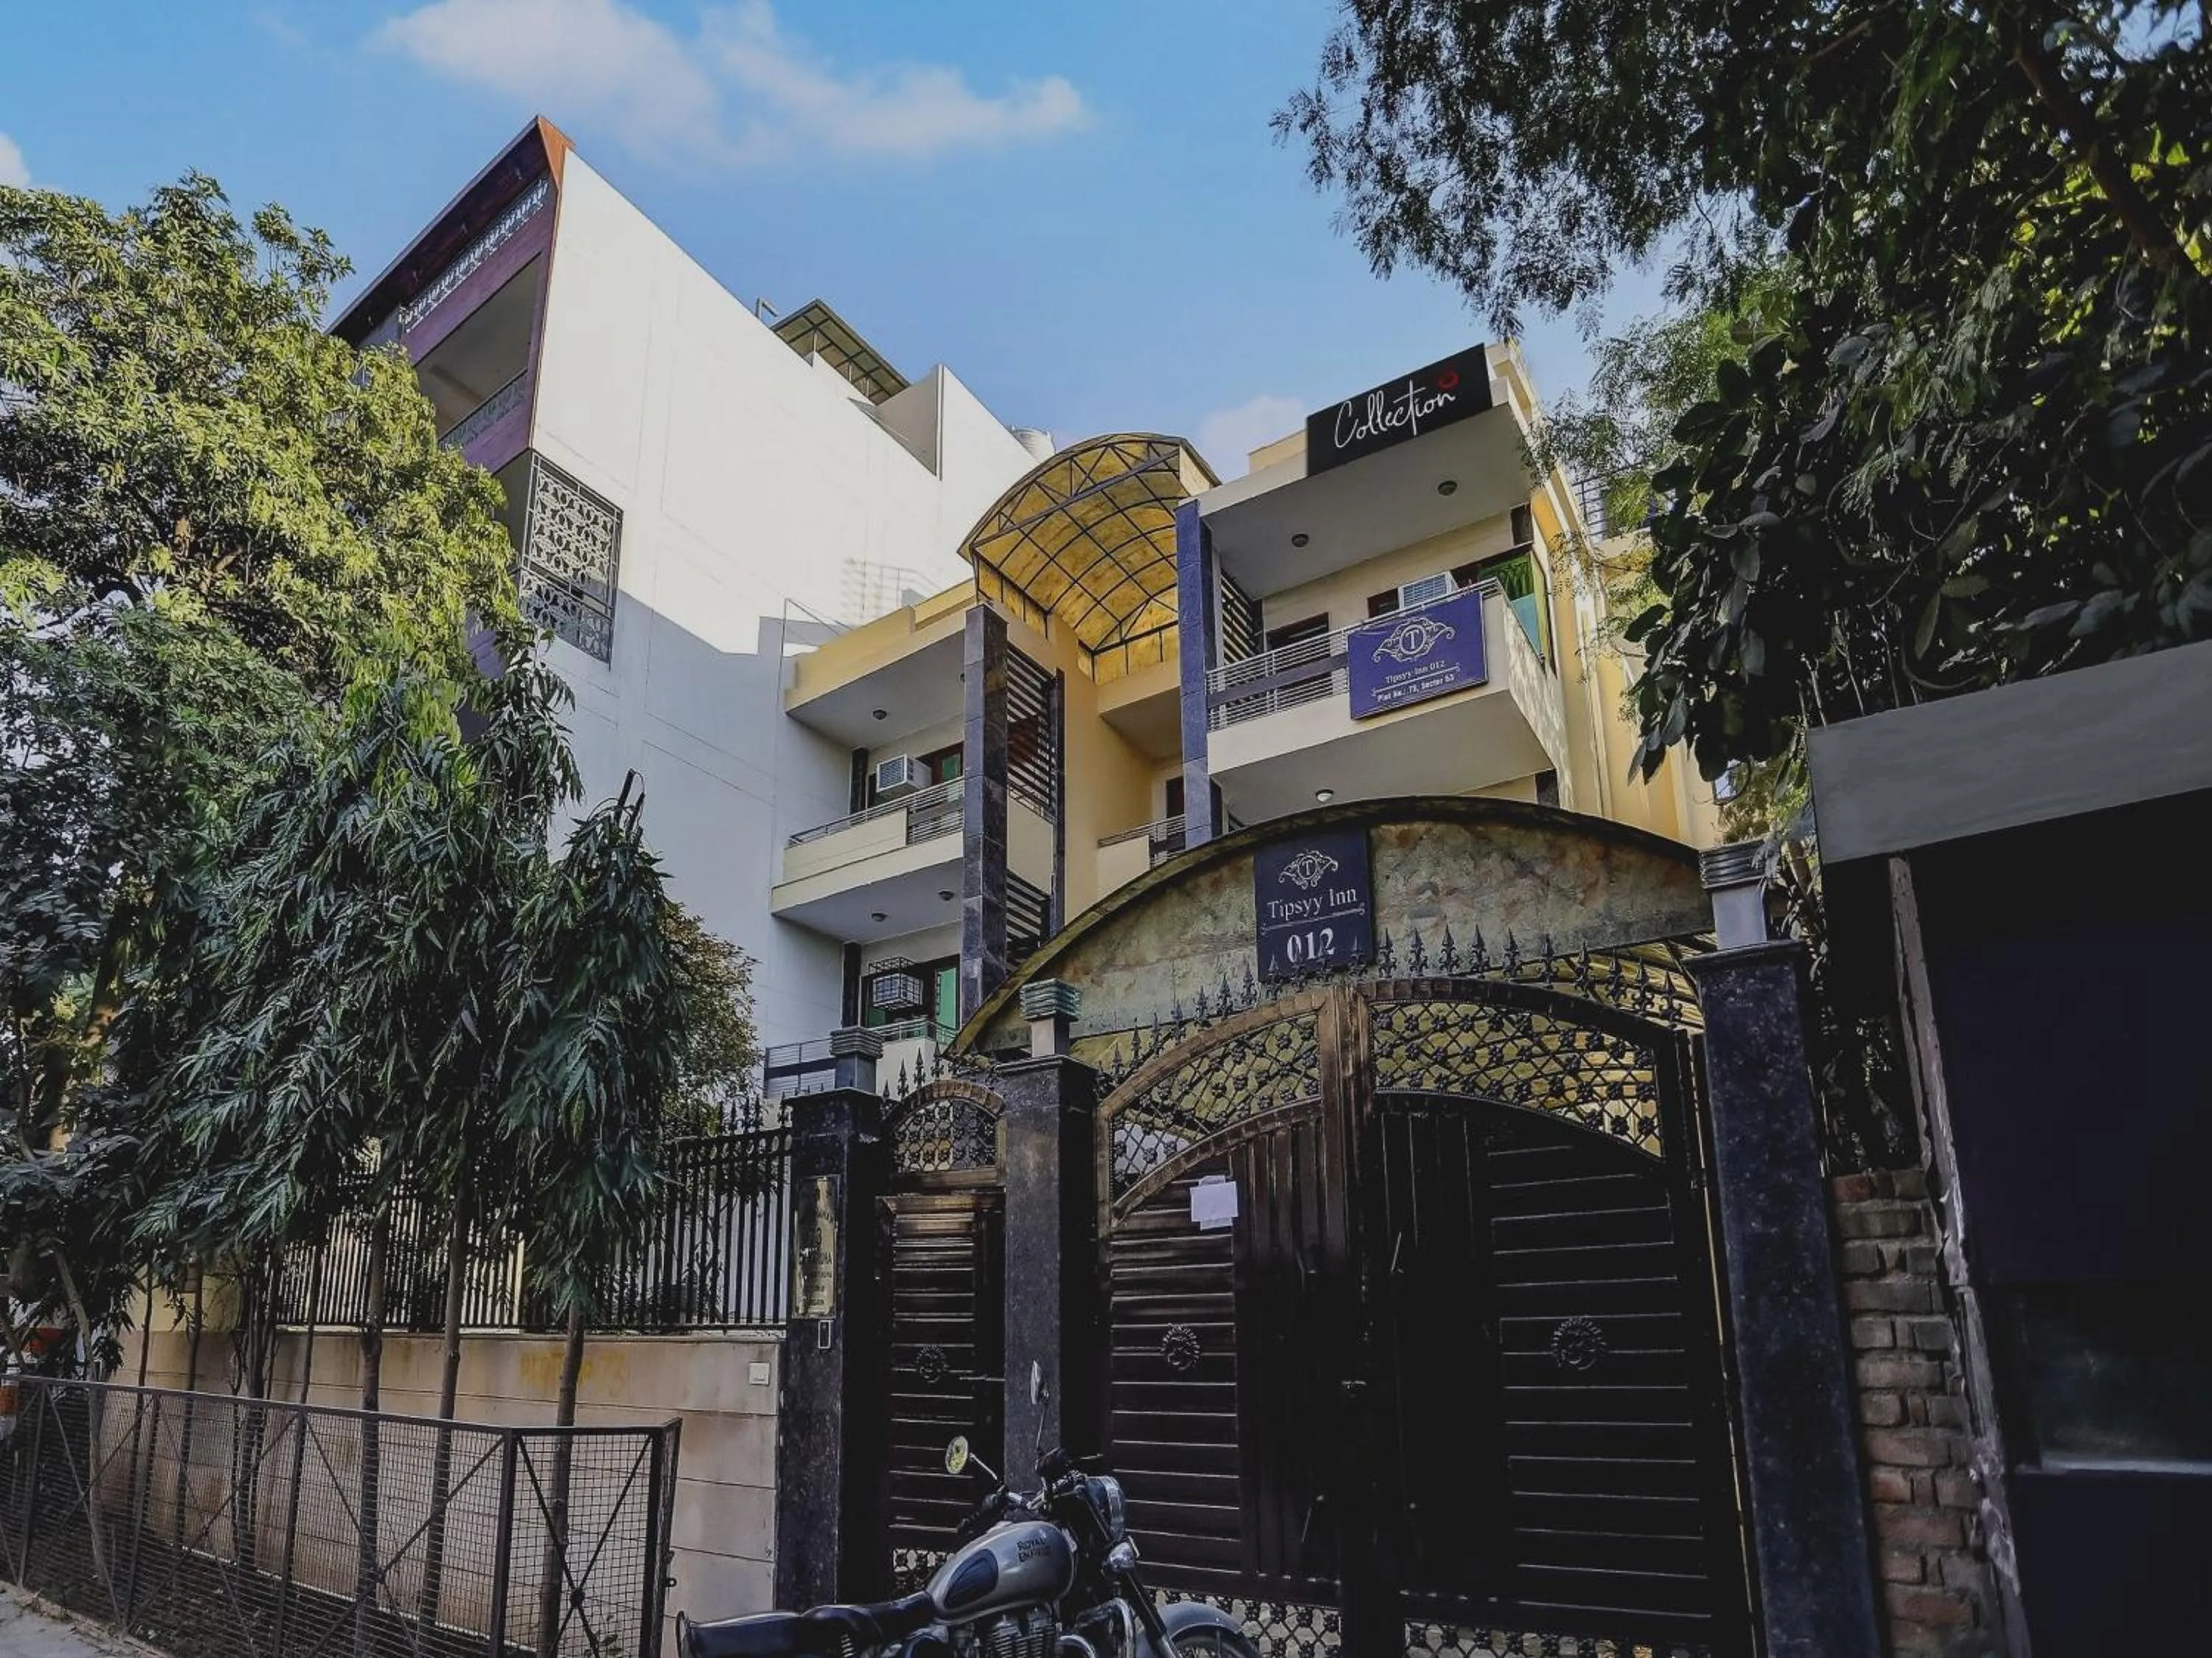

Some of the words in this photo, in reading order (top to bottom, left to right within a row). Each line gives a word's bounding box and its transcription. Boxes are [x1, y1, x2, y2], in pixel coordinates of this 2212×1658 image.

[1334, 379, 1456, 448] Collection
[1405, 629, 1419, 650] T
[1421, 678, 1443, 690] Sector
[1302, 859, 1313, 875] T
[1267, 896, 1323, 920] Tipsyy
[1329, 888, 1357, 906] Inn
[1287, 927, 1336, 962] 012
[1017, 1538, 1046, 1550] ROYAL
